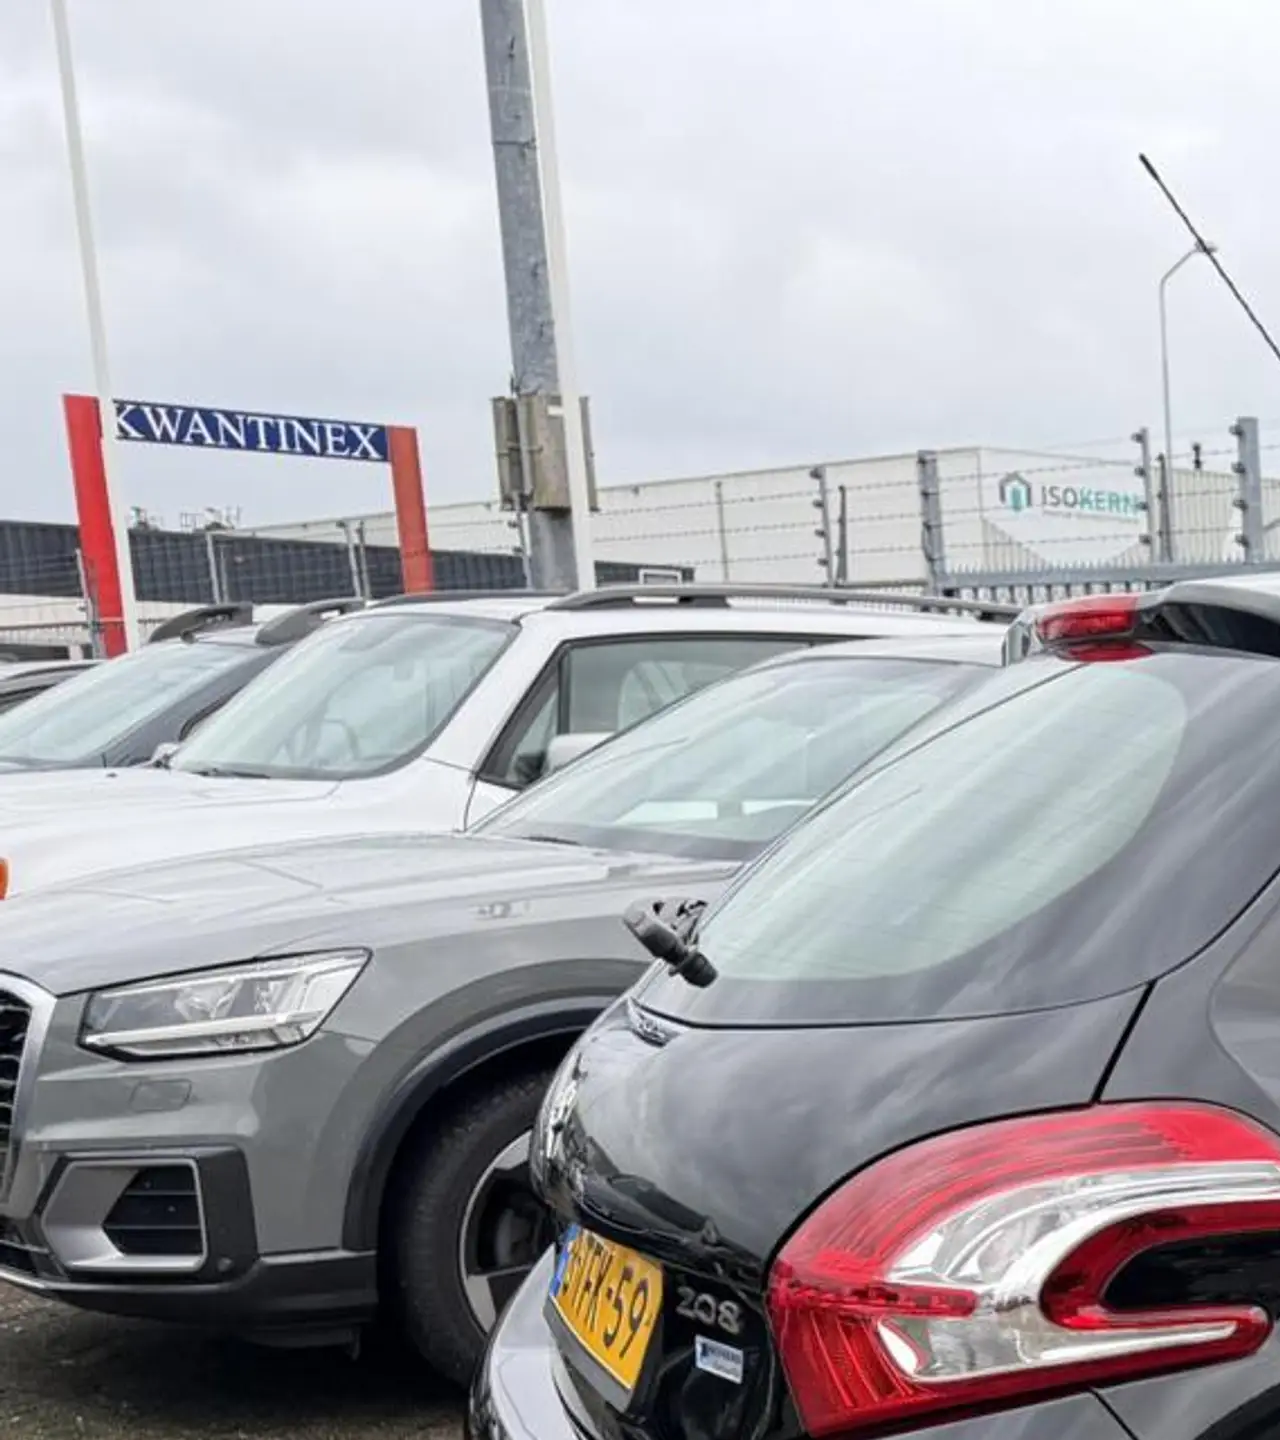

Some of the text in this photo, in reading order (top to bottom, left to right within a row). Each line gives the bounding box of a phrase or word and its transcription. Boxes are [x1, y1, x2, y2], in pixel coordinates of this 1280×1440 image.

[116, 403, 383, 460] KWANTINEX
[1042, 486, 1140, 516] ISOKERN
[676, 1286, 740, 1335] 208
